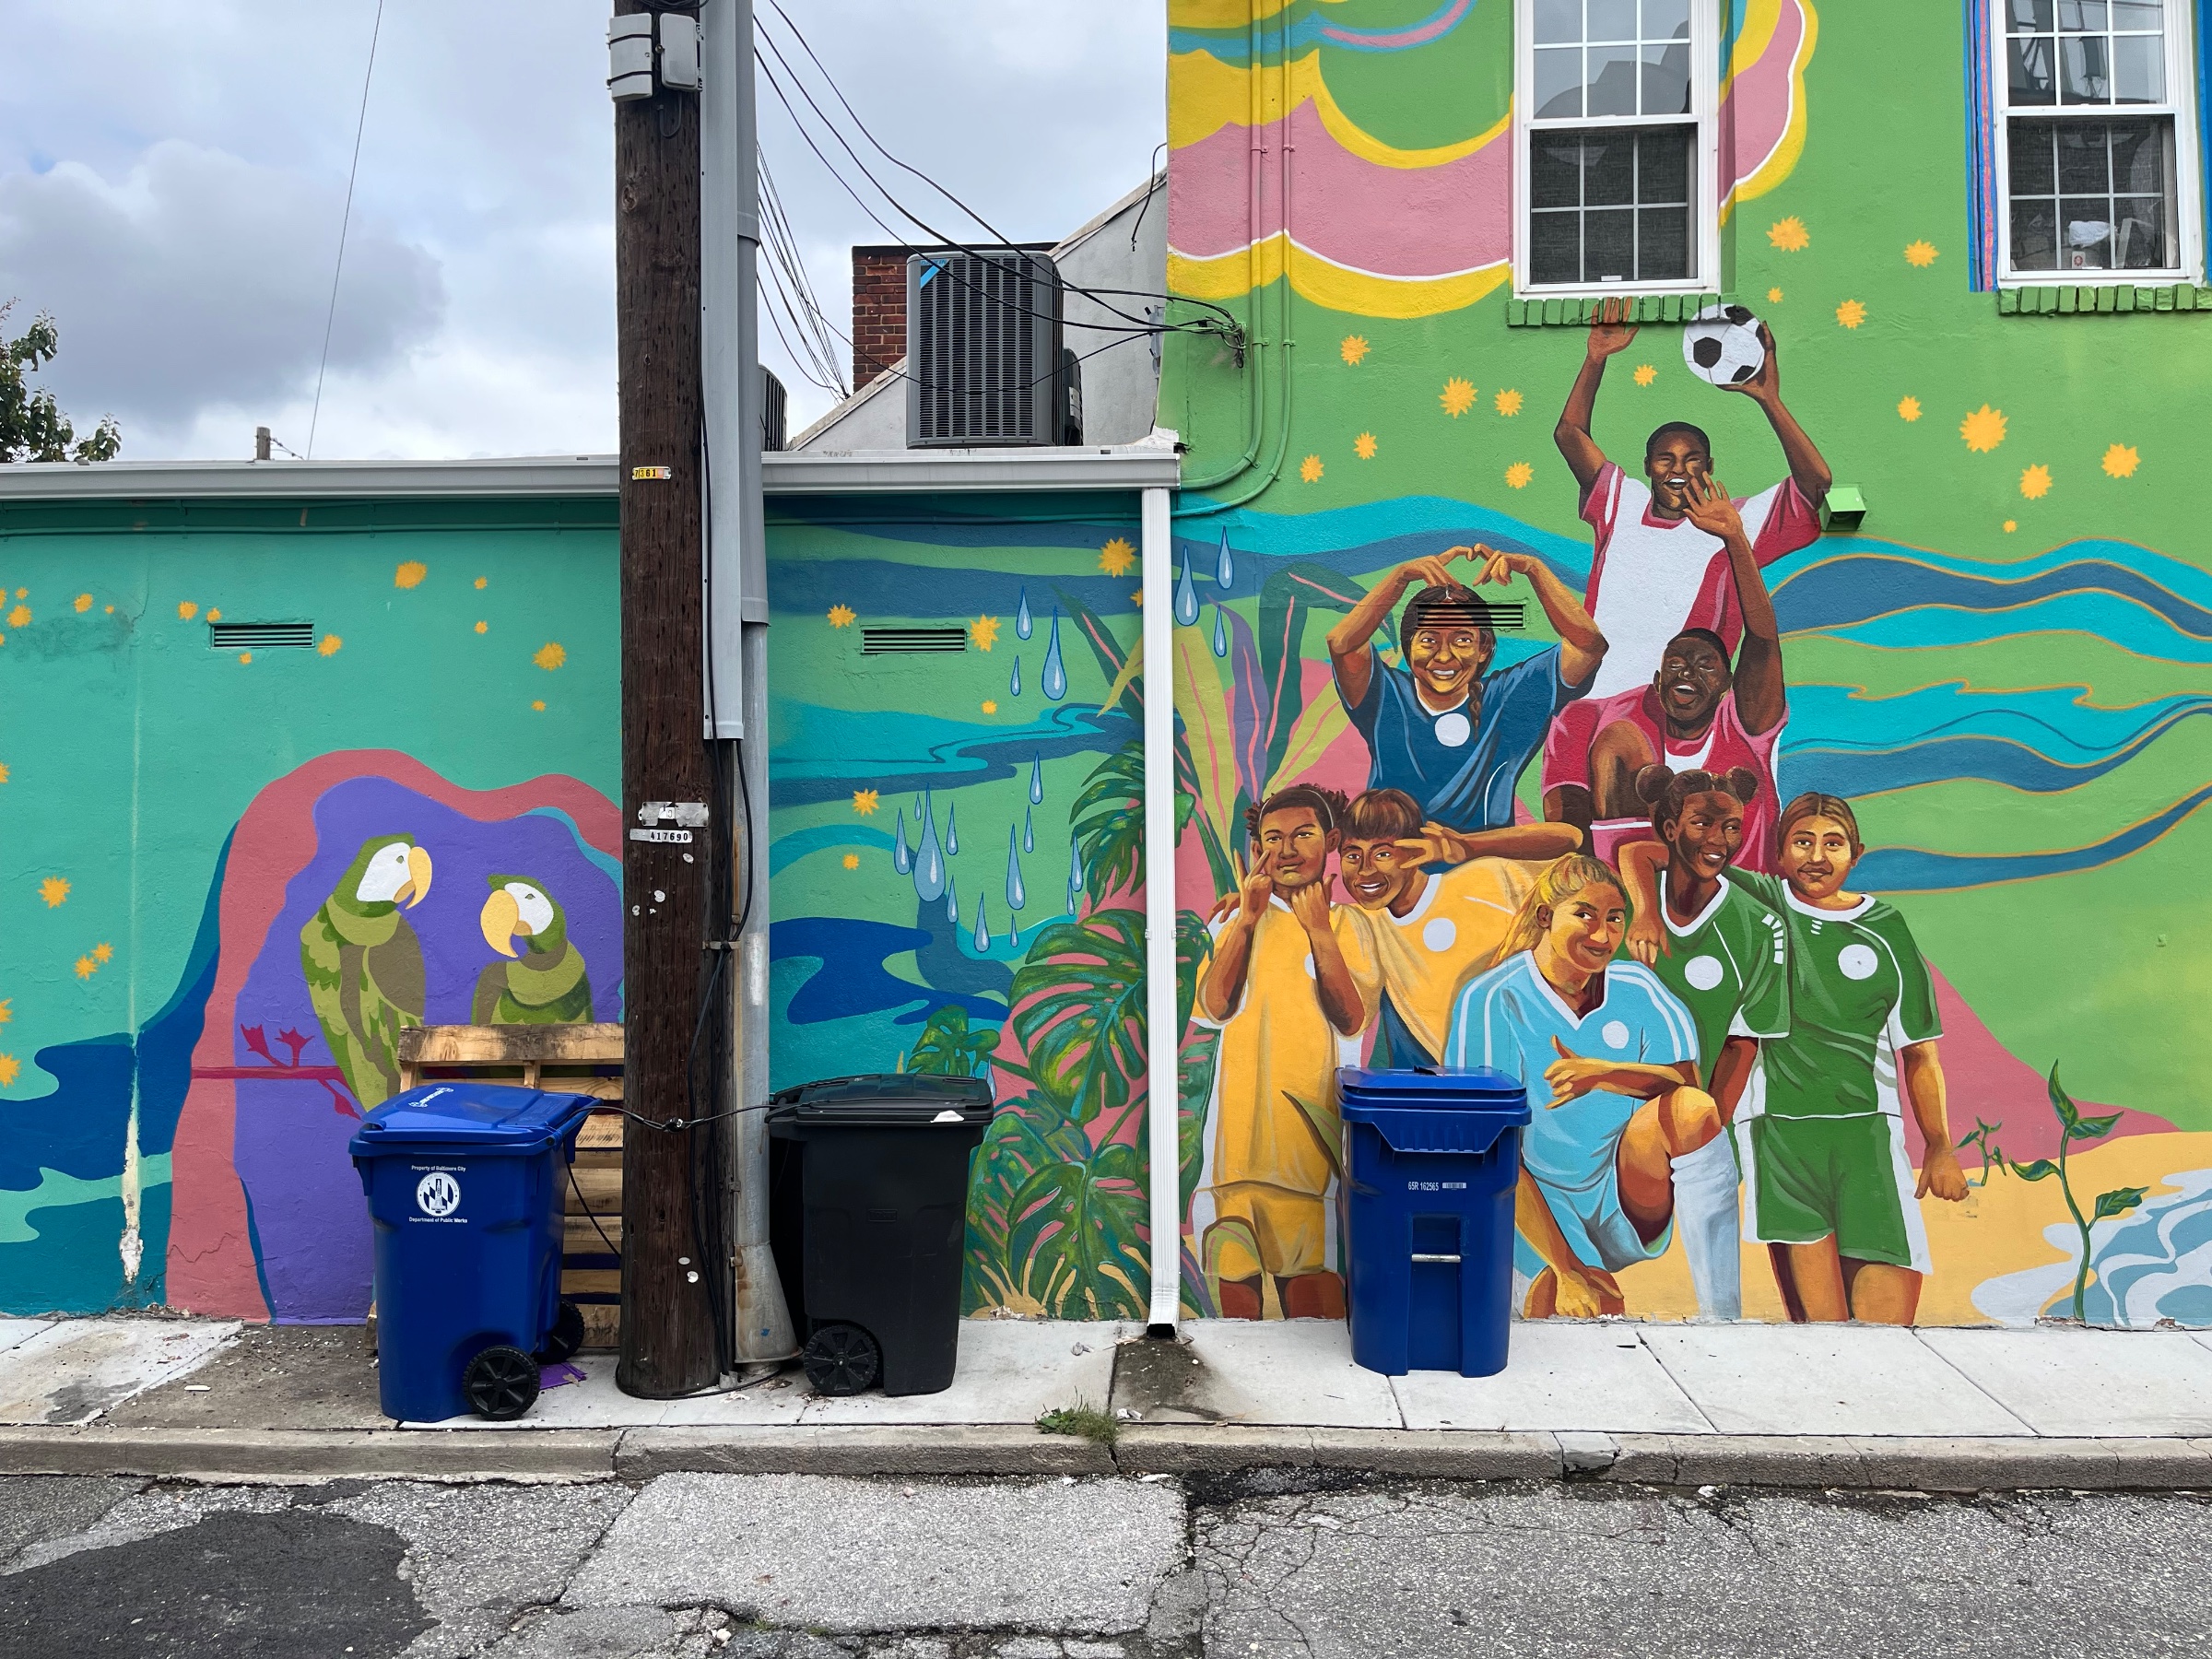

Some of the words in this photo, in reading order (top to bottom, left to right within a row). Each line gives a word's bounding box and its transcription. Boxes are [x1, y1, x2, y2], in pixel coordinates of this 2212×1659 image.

[651, 832, 688, 841] 417690
[1408, 1182, 1418, 1190] 65R
[1420, 1182, 1439, 1191] 162565
